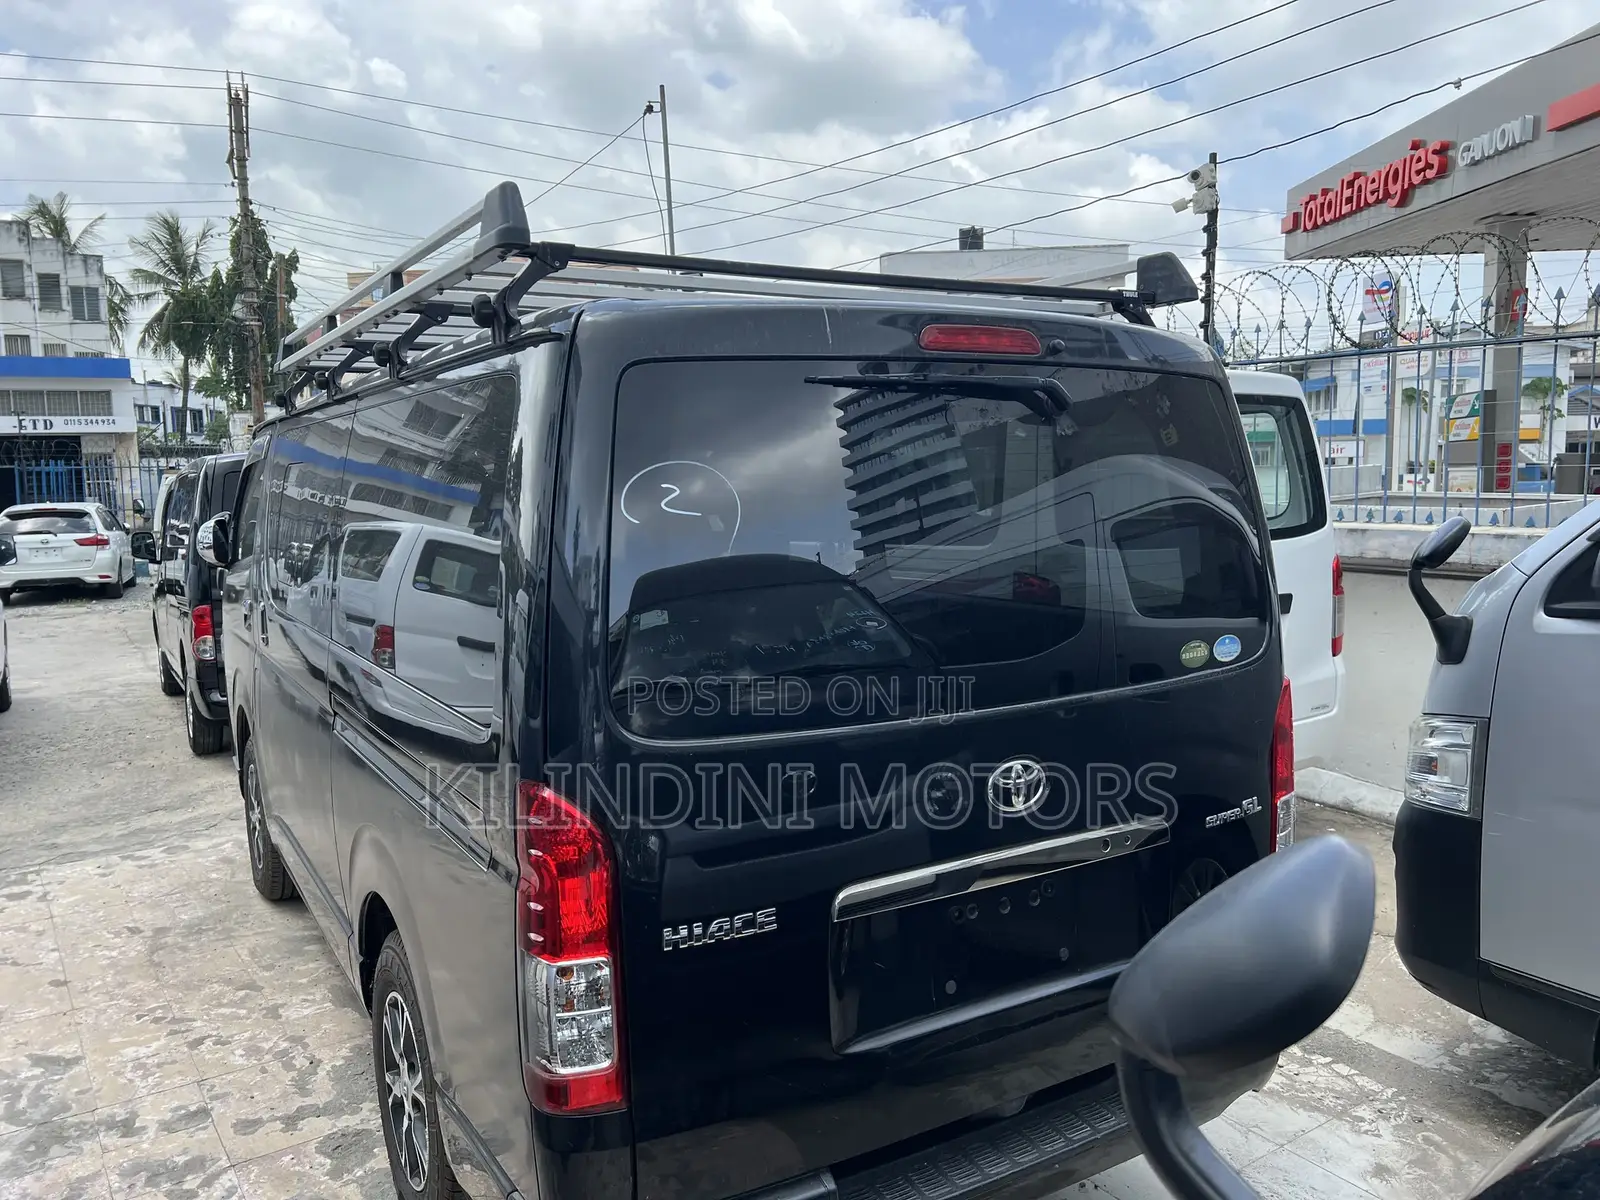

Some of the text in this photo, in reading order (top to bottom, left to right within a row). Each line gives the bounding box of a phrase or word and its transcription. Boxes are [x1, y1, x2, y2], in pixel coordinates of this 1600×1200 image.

[1300, 115, 1533, 232] TotalEnergies GANJONI
[663, 907, 778, 951] HIACE
